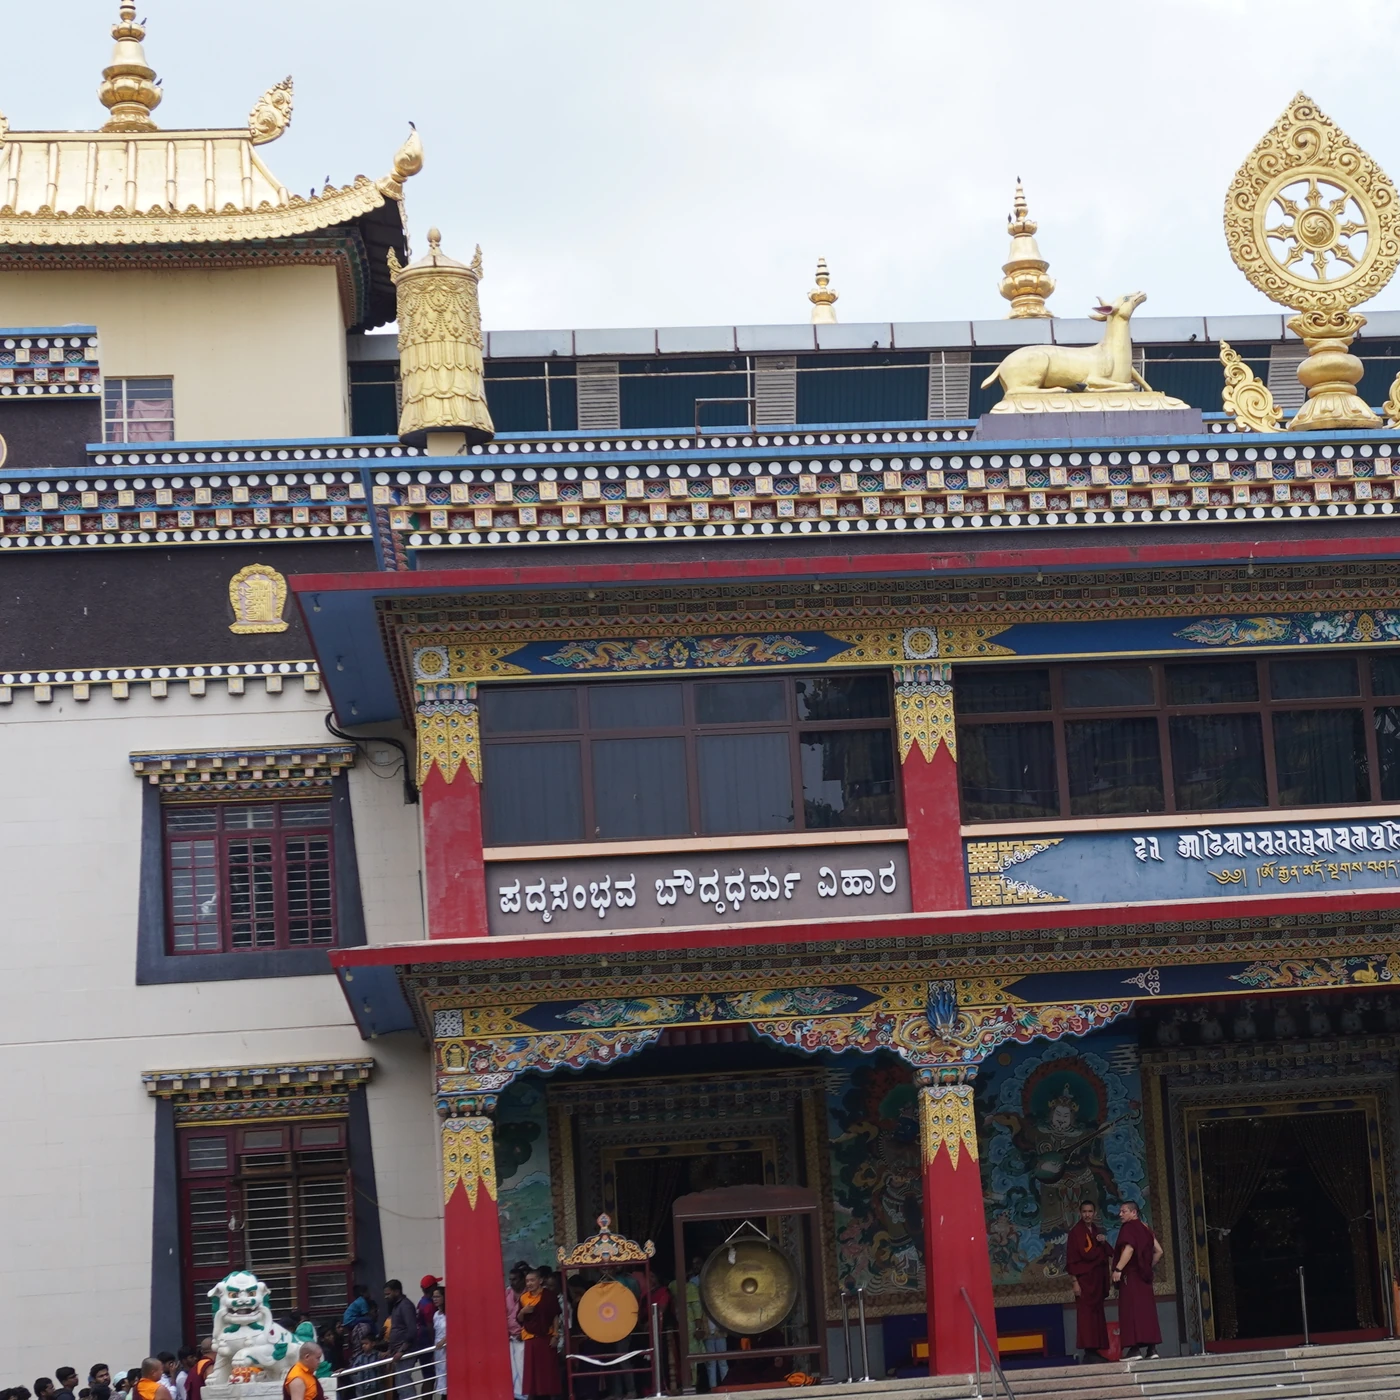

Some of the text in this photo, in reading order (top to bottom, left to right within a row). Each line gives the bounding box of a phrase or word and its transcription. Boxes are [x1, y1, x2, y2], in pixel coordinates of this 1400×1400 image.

[498, 859, 897, 923] ಪದ್ಮಸಂಭವ ಬೌದ್ಧಧರ್ಮ ವಿಹಾರ
